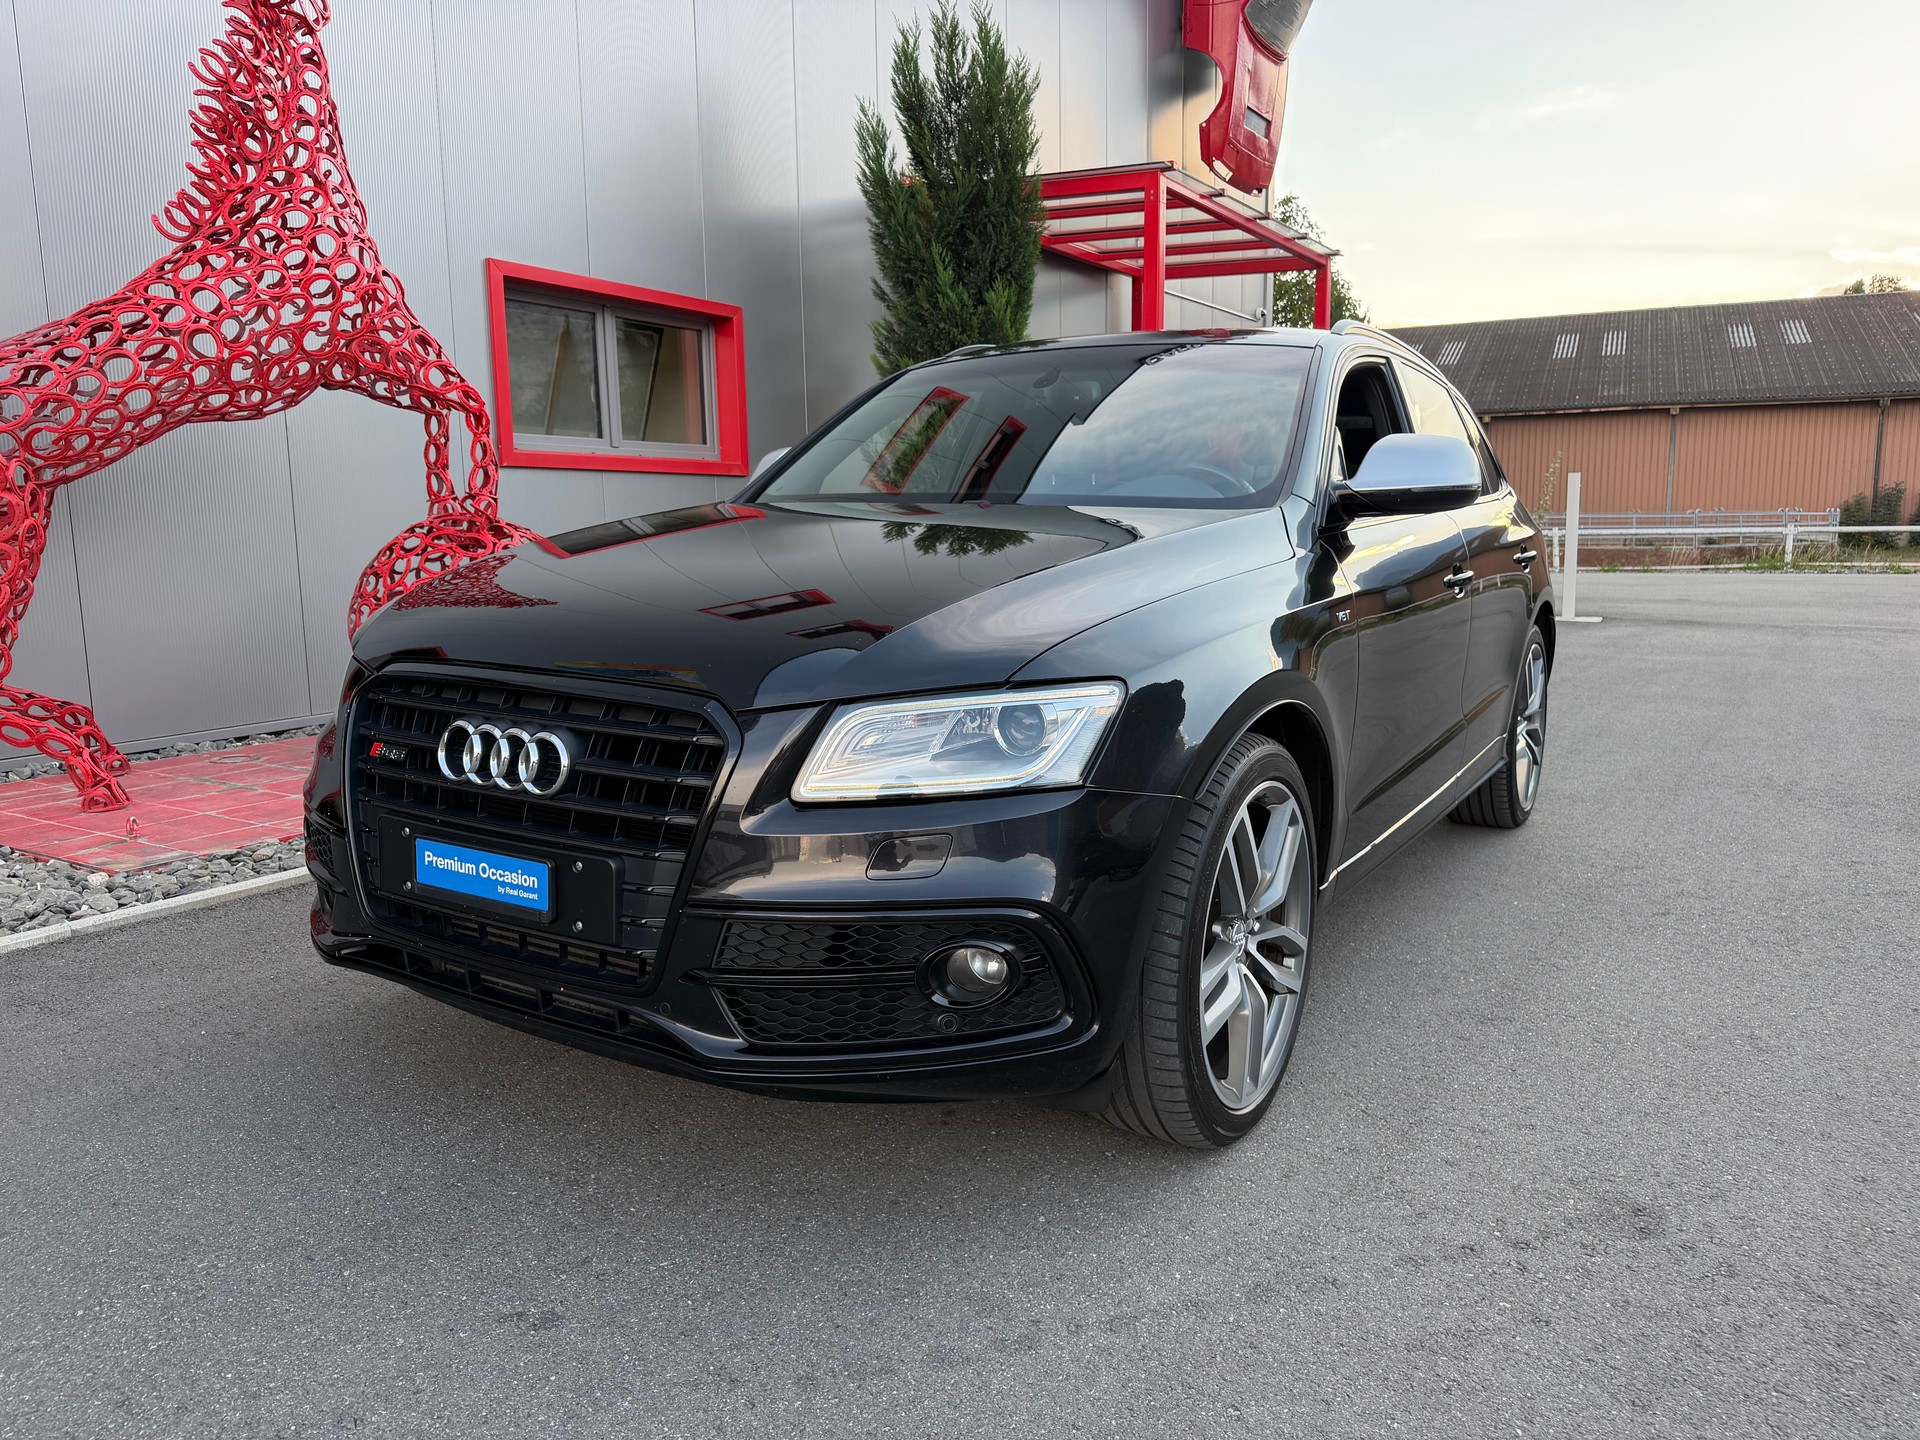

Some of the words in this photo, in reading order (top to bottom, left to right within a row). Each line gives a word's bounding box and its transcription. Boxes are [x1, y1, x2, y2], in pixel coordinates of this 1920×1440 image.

[424, 851, 476, 876] Premium
[478, 862, 539, 889] Occasion
[497, 885, 505, 895] by
[505, 887, 519, 896] Real
[519, 889, 539, 900] Garant
